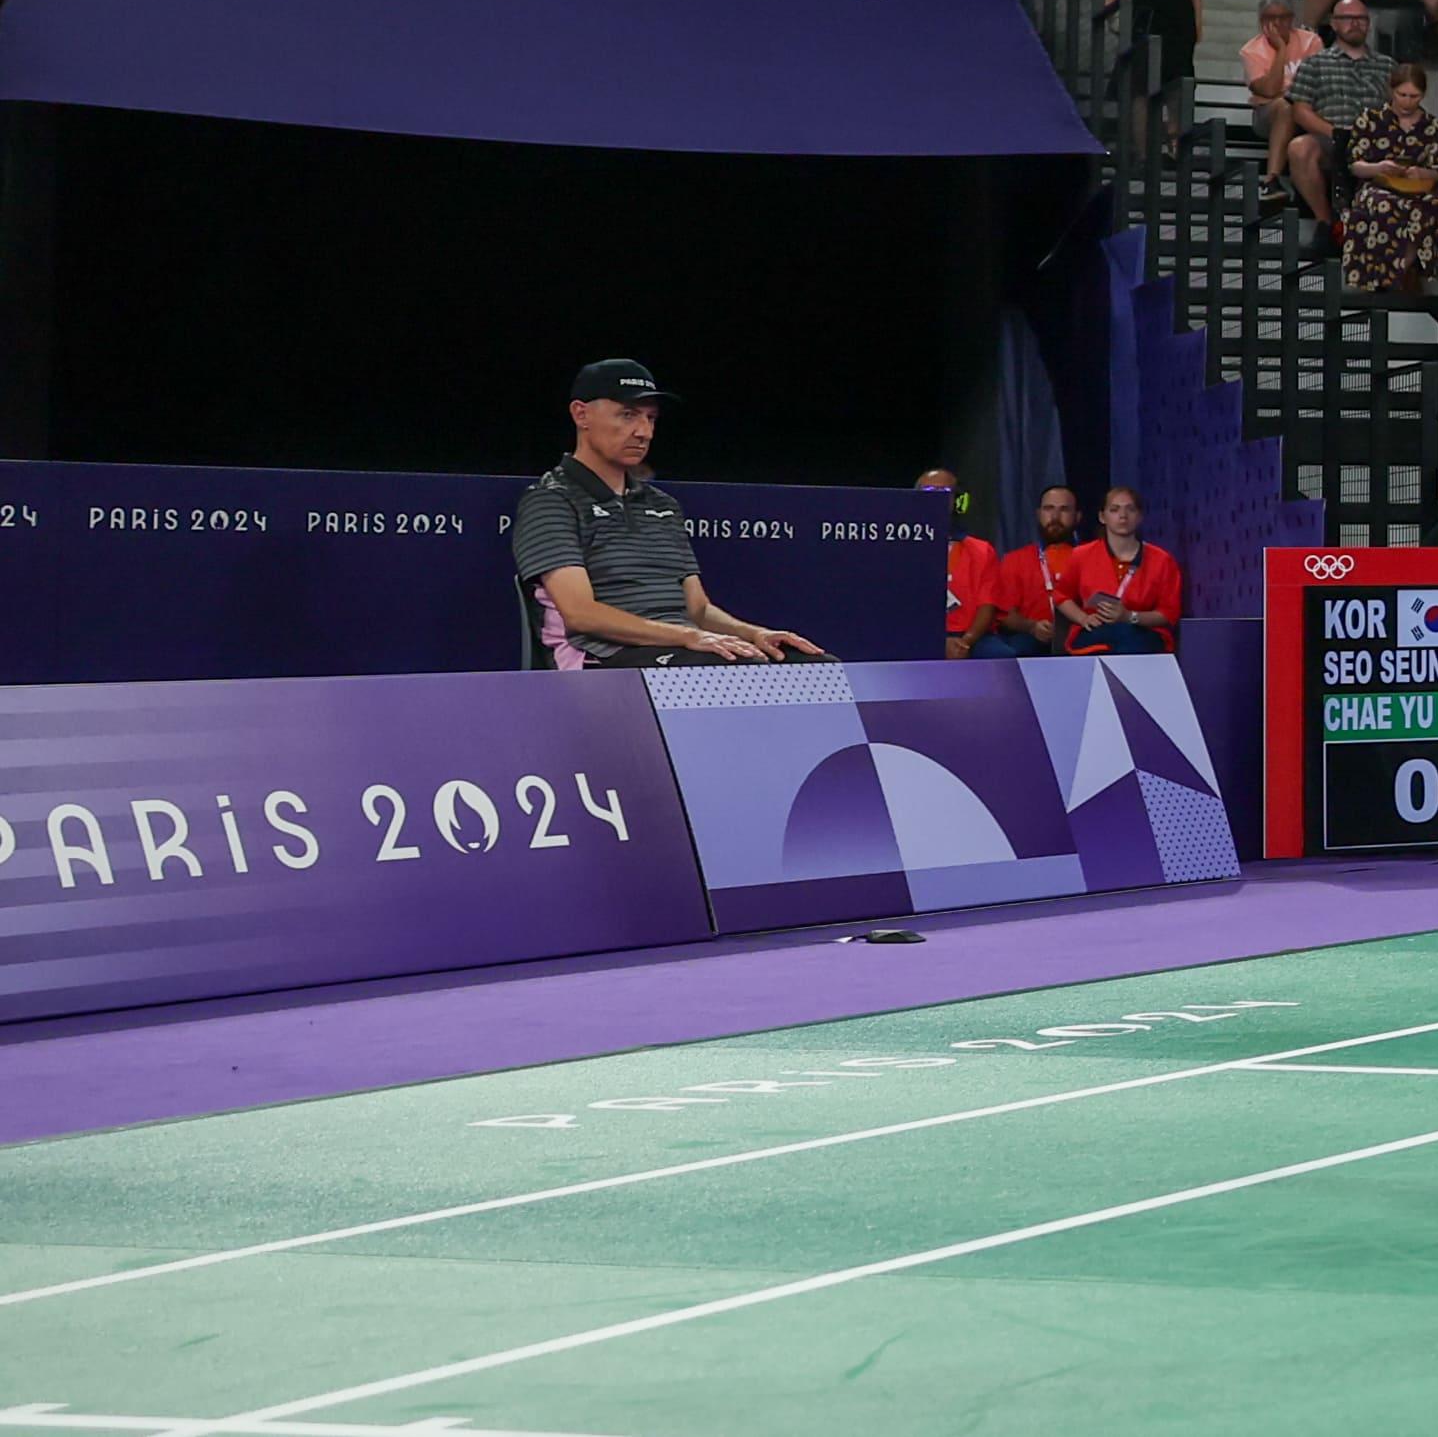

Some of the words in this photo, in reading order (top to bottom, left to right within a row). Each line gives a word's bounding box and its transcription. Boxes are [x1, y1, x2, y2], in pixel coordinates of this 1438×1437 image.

[191, 509, 268, 532] 2024
[396, 512, 463, 534] 2024
[739, 520, 794, 540] 2024
[885, 522, 935, 541] 2024
[1324, 599, 1387, 639] KOR
[1324, 651, 1372, 685] SEO
[1324, 696, 1392, 731] CHAE
[1400, 695, 1433, 728] YU
[361, 772, 629, 861] 2024
[953, 1000, 1302, 1051] 2024
